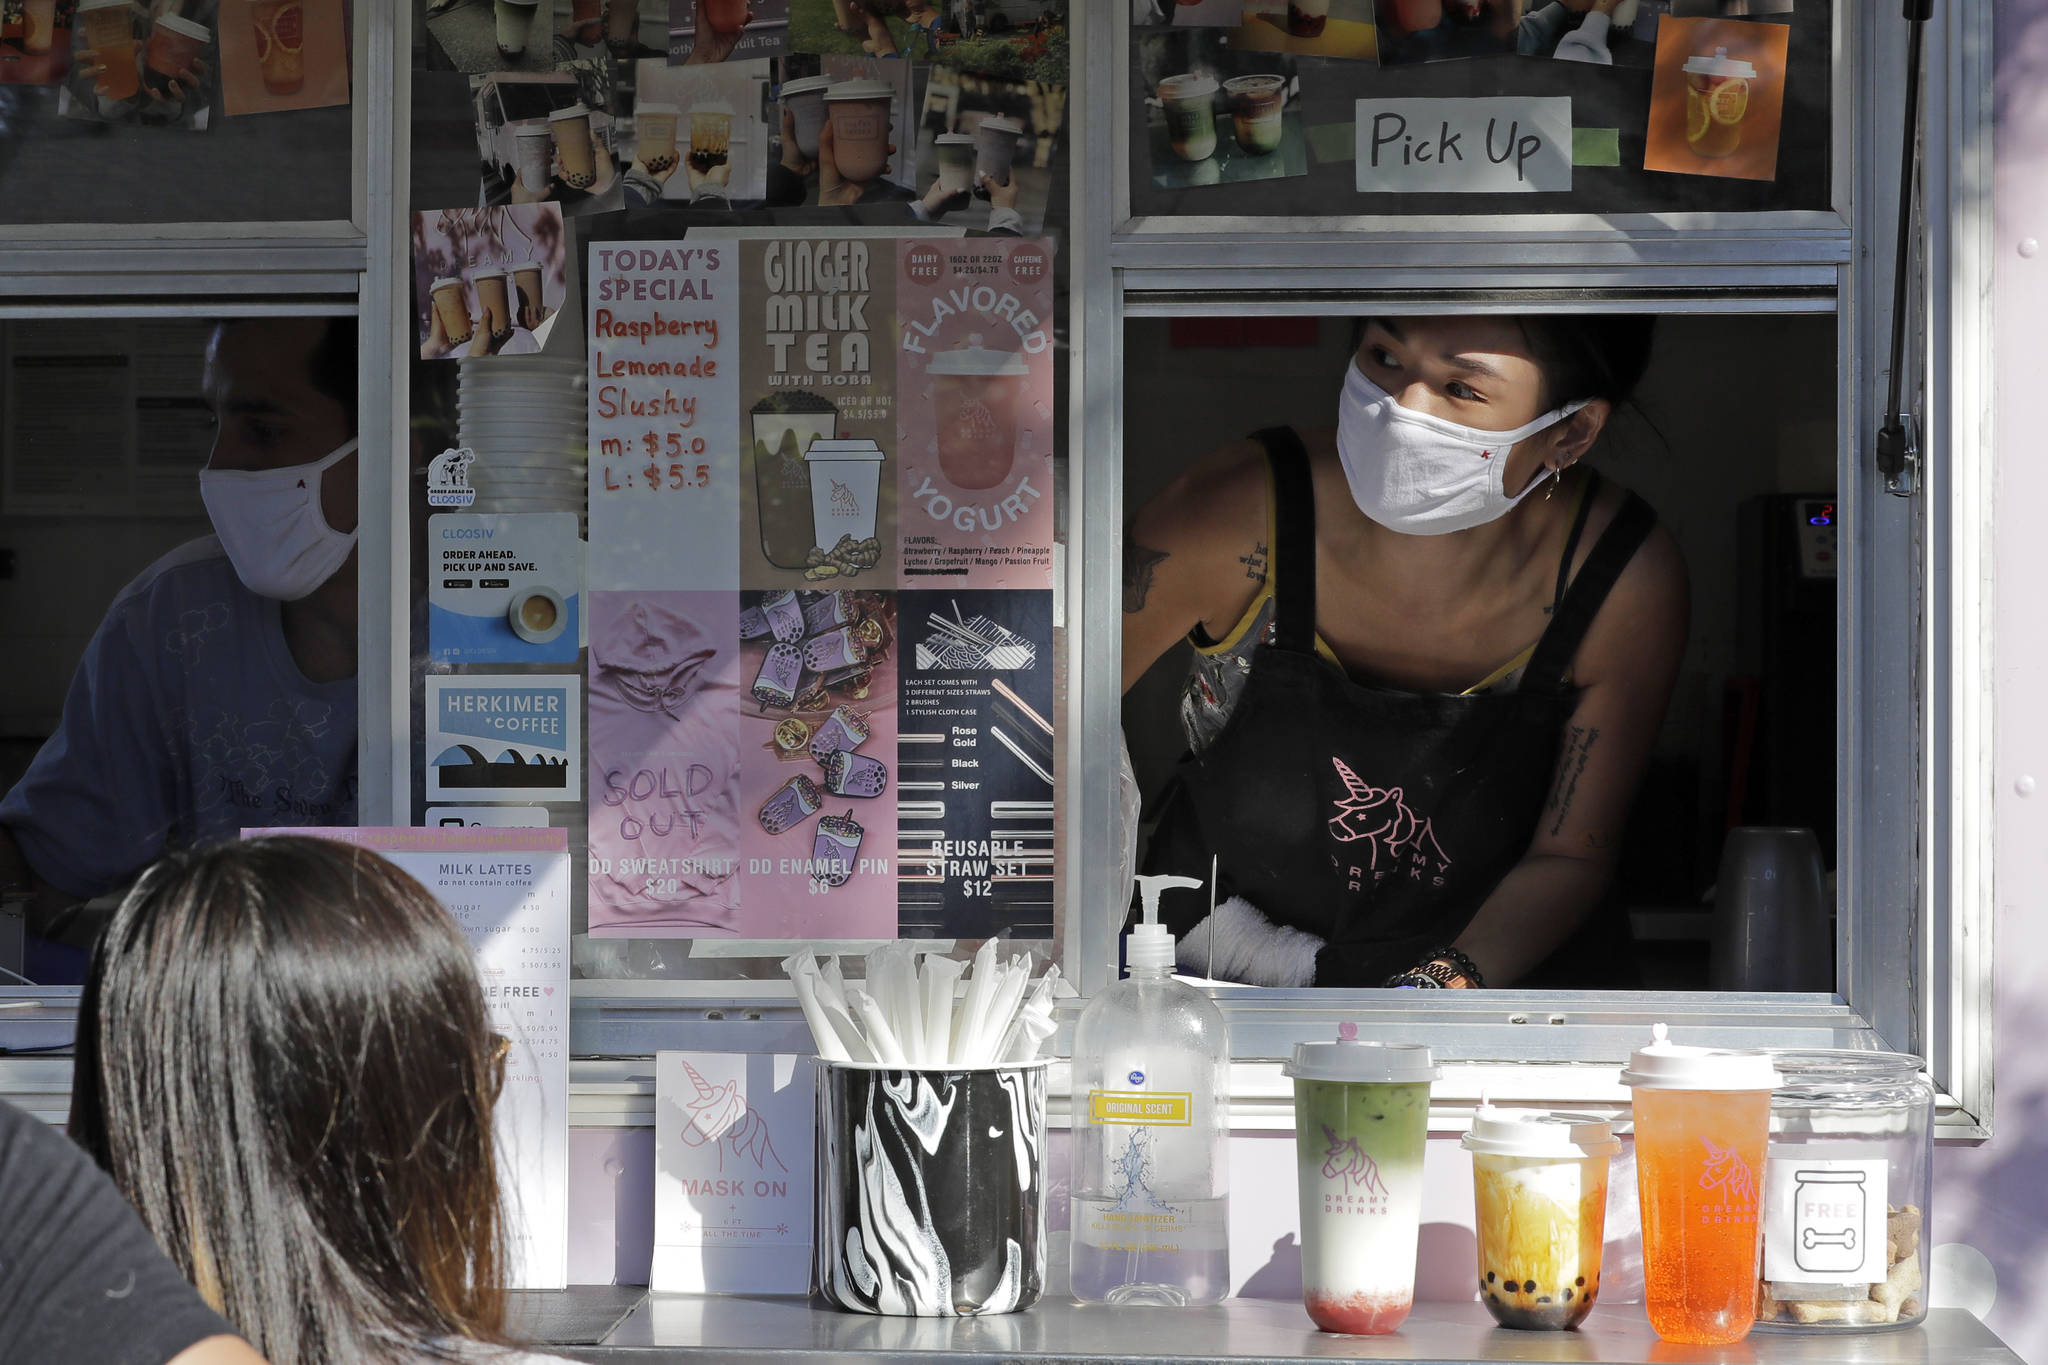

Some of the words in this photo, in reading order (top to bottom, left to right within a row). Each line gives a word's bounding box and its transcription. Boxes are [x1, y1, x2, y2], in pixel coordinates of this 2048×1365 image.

[1371, 112, 1463, 167] Pick
[1486, 117, 1541, 181] Up
[598, 248, 720, 271] TODAY'S
[764, 240, 870, 293] GINGER
[912, 255, 937, 264] DAIRY
[1013, 256, 1042, 264] CAFFEINE
[912, 267, 937, 276] FREE
[1015, 266, 1041, 275] FREE
[599, 278, 714, 301] SPECIAL
[766, 294, 870, 331] MILK
[903, 286, 1047, 355] FLAVORED
[595, 308, 719, 349] Raspberry
[766, 332, 870, 373] TEA
[597, 351, 717, 378] Lemonade
[768, 375, 814, 386] WITH
[822, 374, 871, 385] BOBA
[597, 385, 697, 428] Slushy
[876, 396, 892, 406] HOT
[913, 476, 1041, 532] YOGURT
[443, 551, 475, 559] ORDER
[478, 551, 516, 559] AHEAD.
[904, 547, 941, 556] Strawberry
[948, 547, 982, 556] Raspberry
[989, 547, 1010, 555] Peach
[1016, 547, 1050, 555] Pineapple
[443, 563, 465, 572] PICK
[468, 563, 481, 572] UP
[484, 563, 505, 572] AND
[508, 563, 538, 572] SAVE.
[904, 557, 928, 566] Lychee
[934, 557, 968, 566] Grapefruit
[975, 557, 998, 566] Mango
[1004, 557, 1031, 565] Passion
[1033, 557, 1049, 565] Fruit
[448, 696, 559, 713] HERKIMER
[494, 717, 559, 735] COFFEE
[952, 727, 977, 735] Rose
[953, 739, 977, 747] Gold
[603, 764, 713, 806] SOLD
[951, 781, 980, 790] Silver
[620, 810, 704, 840] OUT
[932, 840, 1023, 857] REUSABLE
[439, 864, 473, 875] MILK
[479, 864, 533, 875] LATTES
[589, 859, 612, 875] DD
[619, 858, 732, 875] SWEATSHIRT
[749, 859, 772, 875] DD
[780, 859, 852, 875] ENAMEL
[859, 859, 889, 875] PIN
[926, 861, 988, 877] STRAW
[995, 861, 1028, 877] SET
[646, 878, 677, 895] $20
[808, 878, 830, 895] $6
[963, 880, 992, 898] $12
[451, 904, 481, 912] sugar
[484, 926, 511, 934] sugar
[503, 986, 540, 997] FREE
[1106, 1102, 1144, 1113] ORIGINAL
[1145, 1103, 1173, 1115] SCENT
[681, 1179, 745, 1197] MASK
[754, 1181, 787, 1197] ON
[1325, 1194, 1388, 1203] DREAMY
[1325, 1206, 1388, 1215] DRINKS
[1804, 1202, 1857, 1218] FREE
